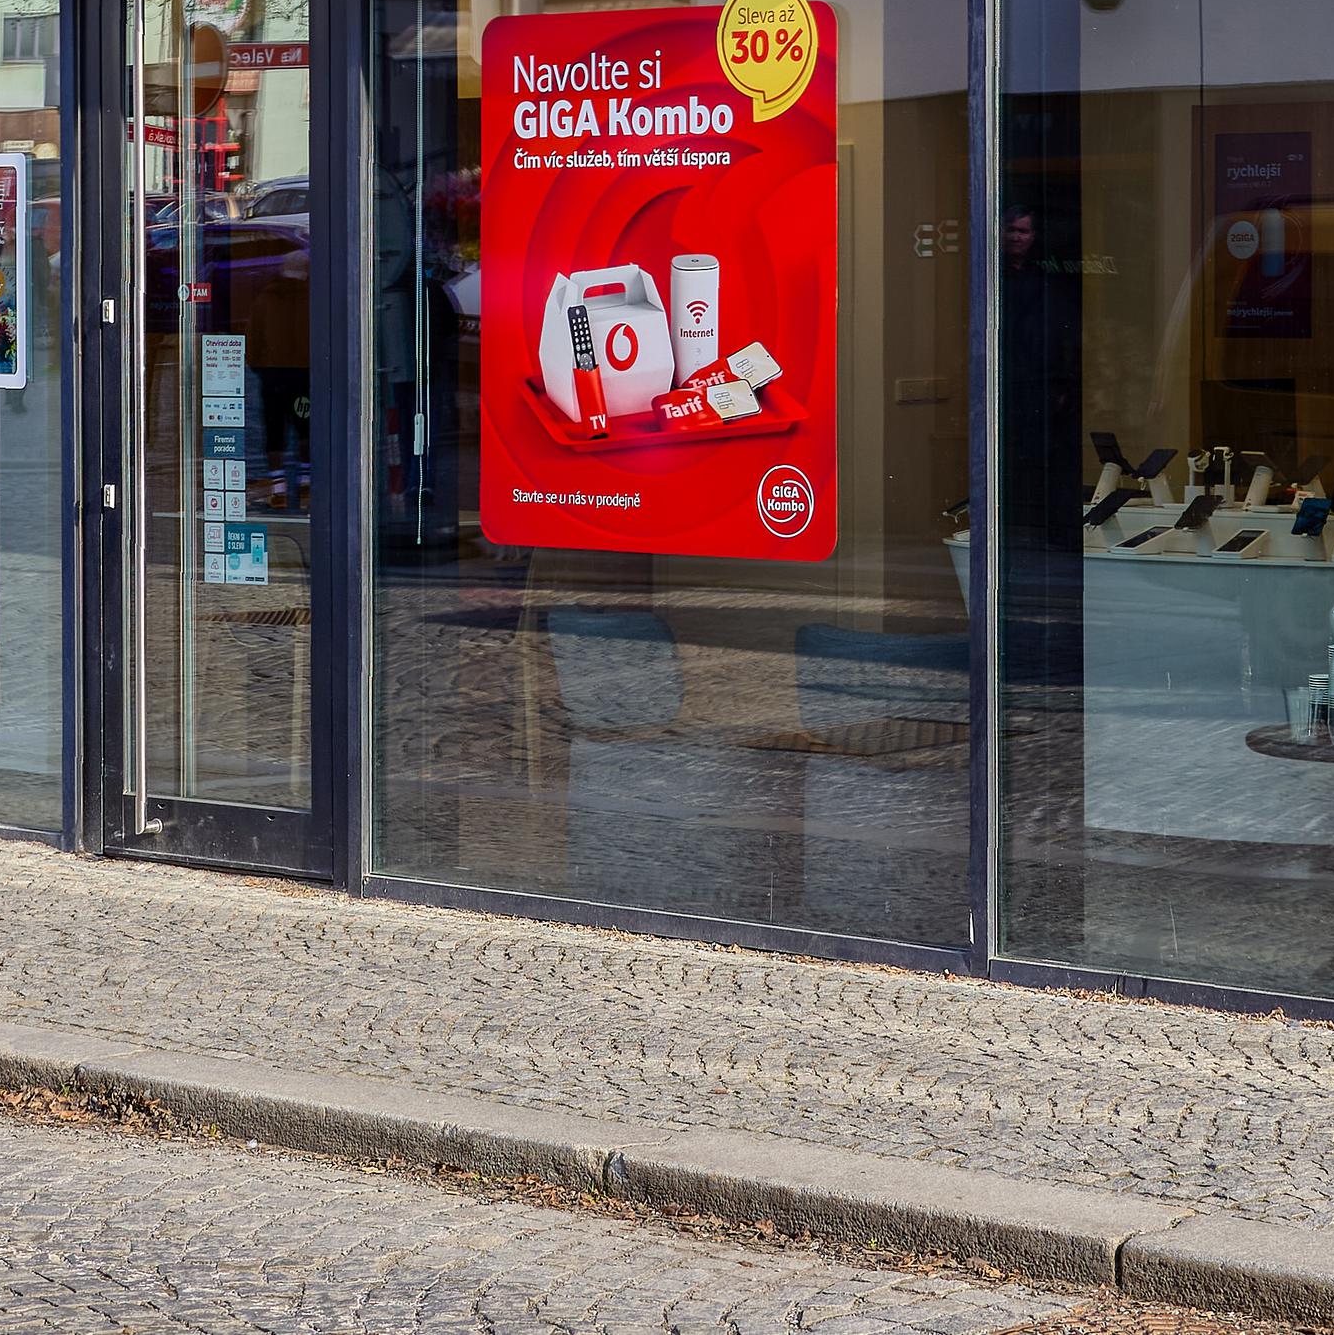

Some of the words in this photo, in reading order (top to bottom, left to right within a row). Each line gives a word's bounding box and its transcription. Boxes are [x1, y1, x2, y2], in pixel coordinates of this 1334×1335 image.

[737, 6, 775, 26] Sleva
[778, 4, 796, 23] až
[730, 29, 770, 65] 30
[775, 28, 804, 63] %
[513, 52, 630, 93] Navolte
[638, 50, 662, 89] si
[513, 99, 601, 139] GIGA
[608, 96, 734, 137] Kombo
[513, 148, 545, 169] Čím
[547, 149, 564, 168] víc
[566, 148, 615, 169] služeb,
[617, 149, 641, 168] tím
[643, 147, 679, 168] větší
[682, 147, 731, 170] úspora
[680, 328, 714, 339] Internet
[688, 371, 726, 390] Tarif
[660, 395, 704, 419] Tarif
[589, 414, 606, 430] TV
[512, 488, 544, 504] Stavte
[546, 493, 557, 504] se
[559, 494, 566, 505] u
[568, 491, 587, 506] nás
[588, 496, 595, 506] v
[596, 493, 641, 510] prodejně
[772, 485, 800, 499] GIGA
[767, 498, 806, 513] Kombo
